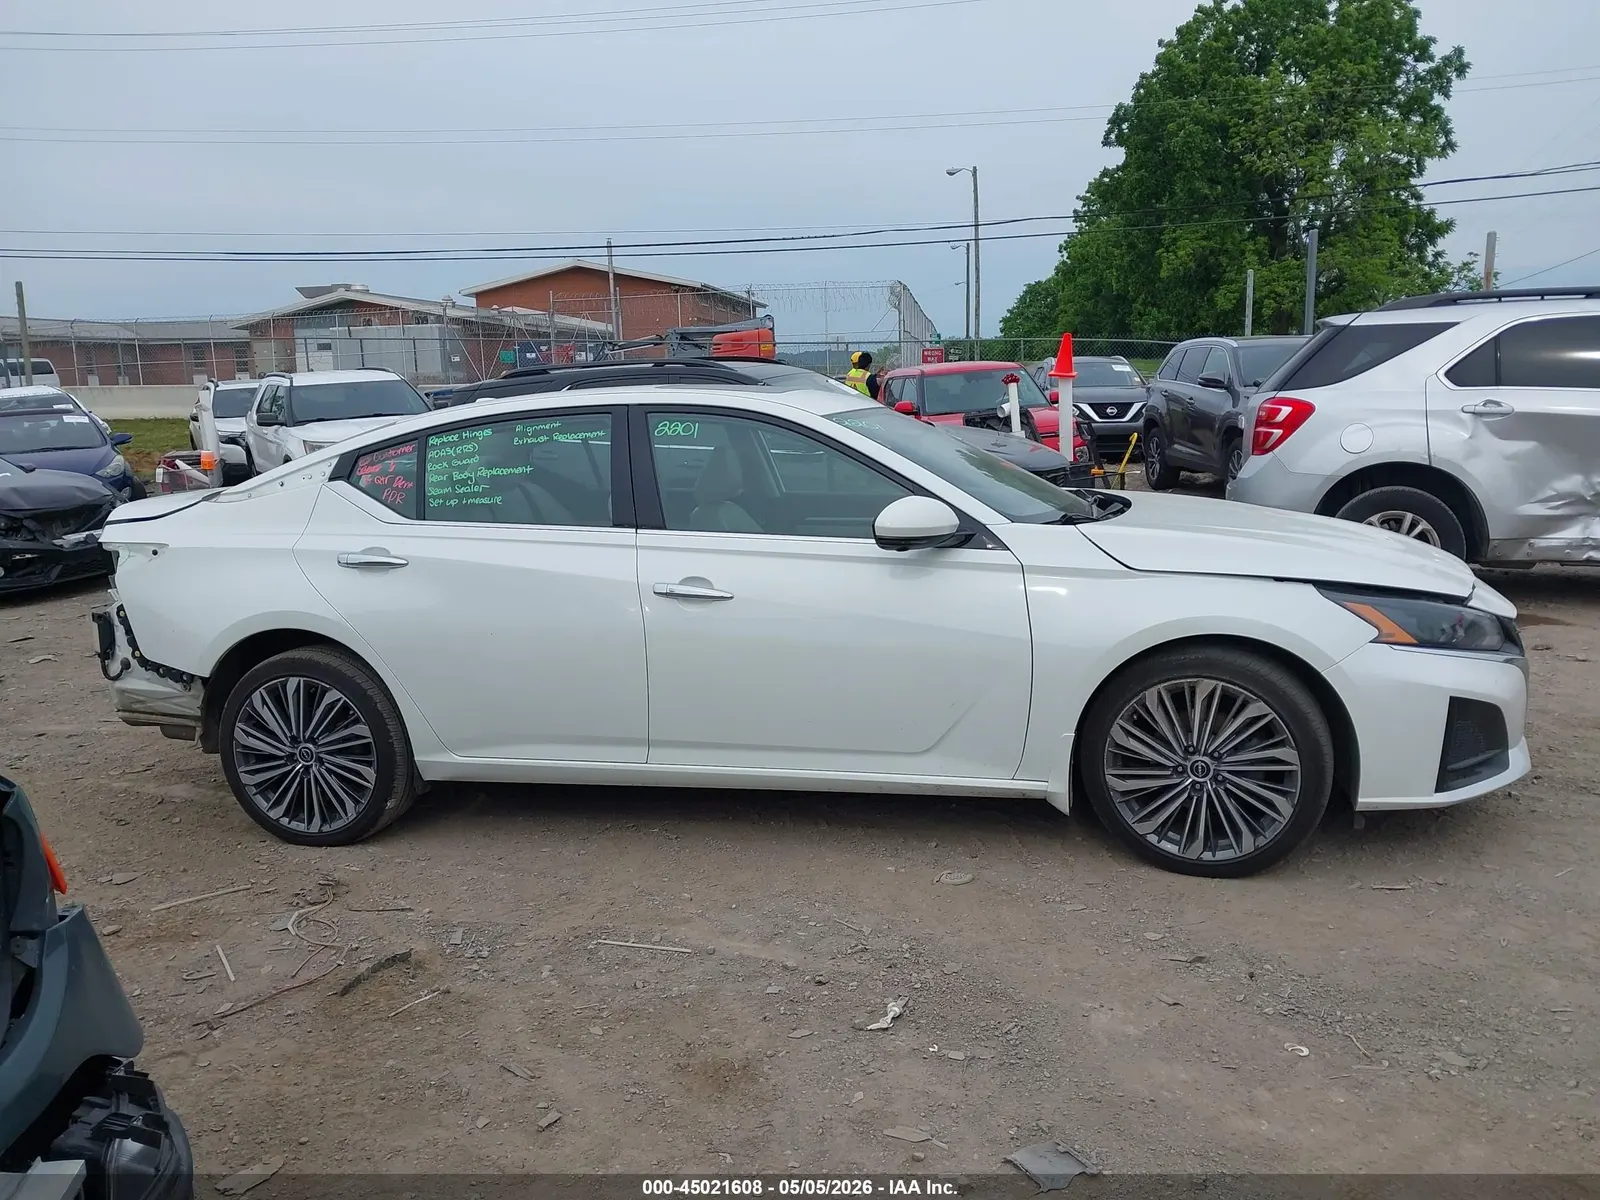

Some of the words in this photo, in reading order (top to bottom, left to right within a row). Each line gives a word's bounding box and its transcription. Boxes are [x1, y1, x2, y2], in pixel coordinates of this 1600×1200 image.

[515, 421, 562, 436] Alignment
[552, 430, 607, 441] Replacement
[654, 421, 699, 439] 2201
[428, 434, 460, 447] Replace
[462, 428, 493, 441] Hinges
[427, 461, 449, 472] Rock
[451, 454, 480, 467] Guard
[428, 473, 449, 483] Rear
[452, 470, 475, 485] Body
[476, 465, 535, 479] Replacement
[427, 486, 452, 496] Seam
[454, 484, 490, 494] Sealer
[428, 498, 444, 507] Set
[445, 498, 459, 507] up
